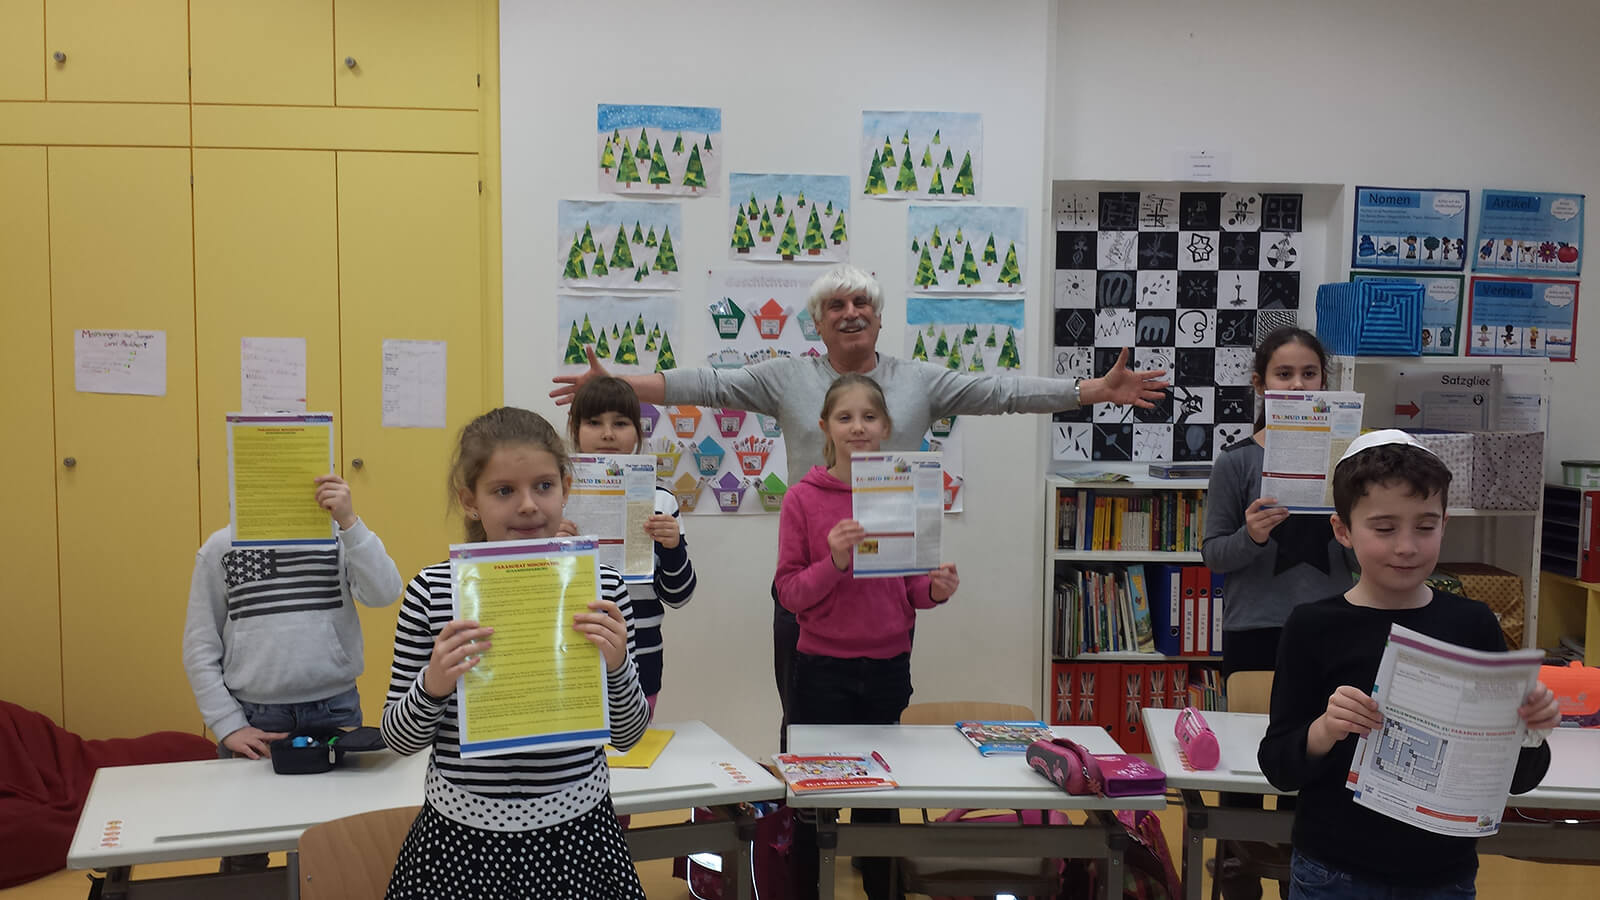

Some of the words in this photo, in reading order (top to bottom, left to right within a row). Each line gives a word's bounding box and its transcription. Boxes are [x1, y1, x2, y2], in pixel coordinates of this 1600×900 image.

[1369, 191, 1411, 206] Nomen
[1492, 198, 1532, 210] Artikel
[1482, 284, 1526, 297] Verben
